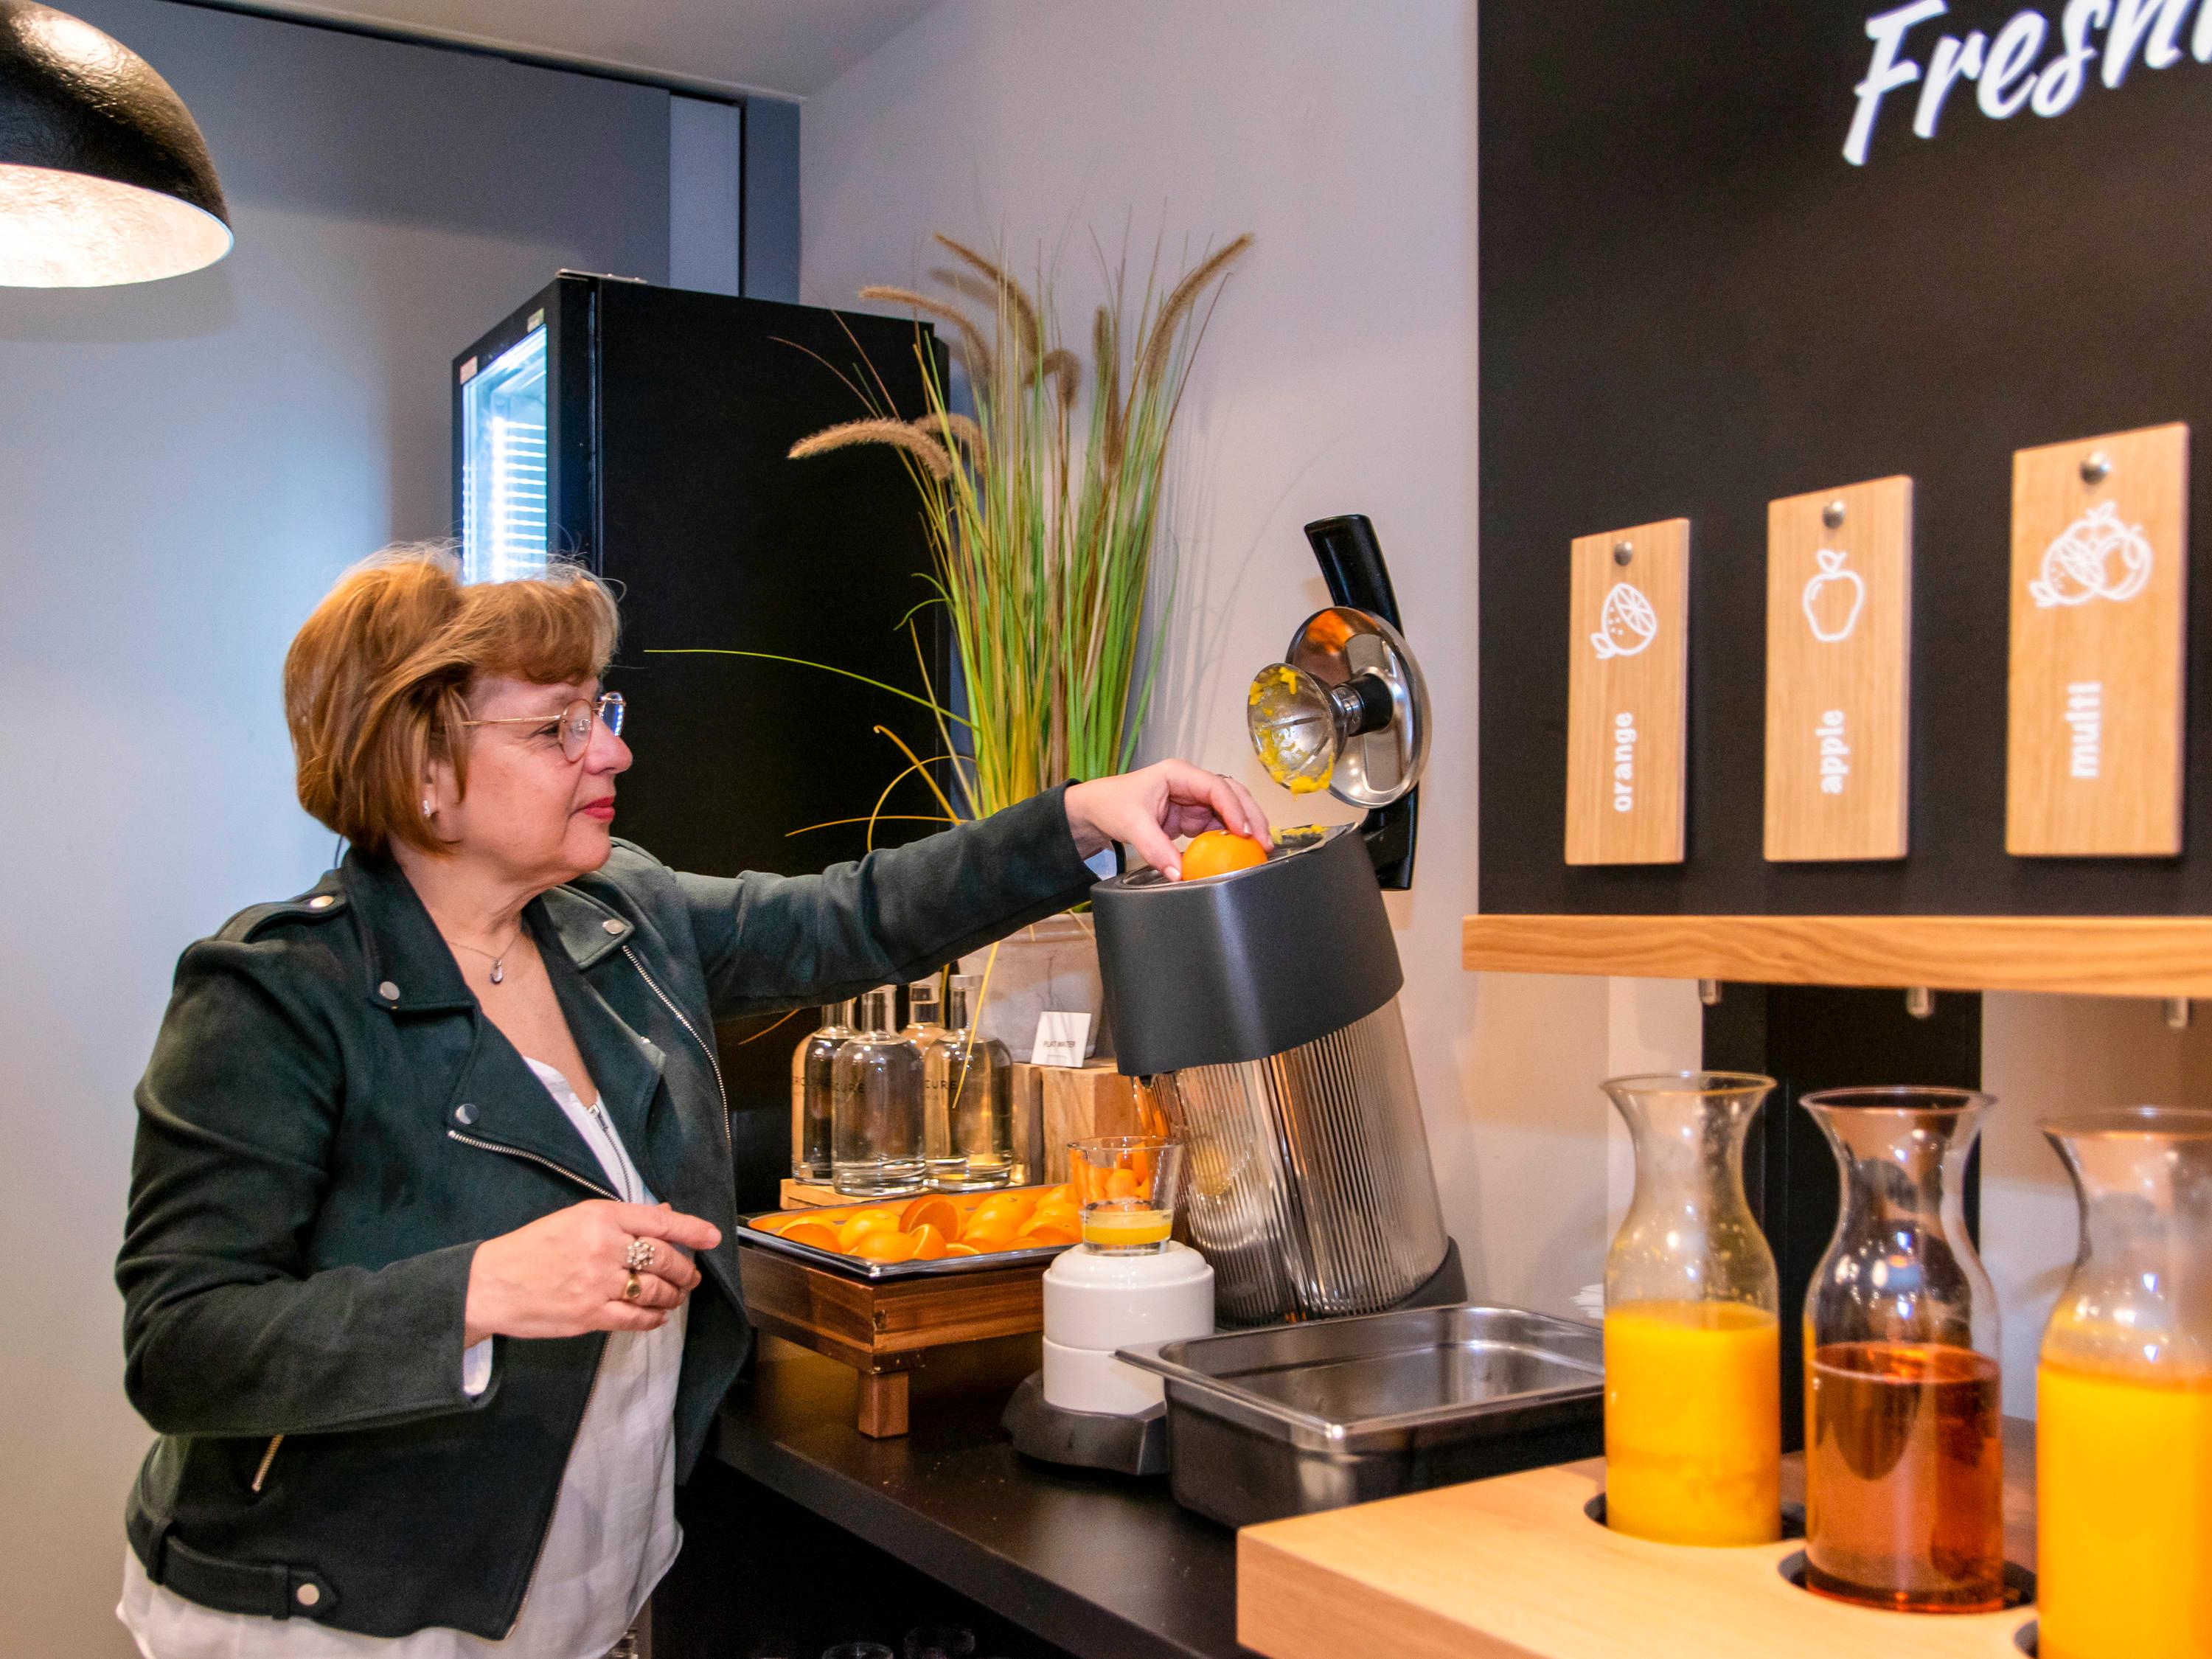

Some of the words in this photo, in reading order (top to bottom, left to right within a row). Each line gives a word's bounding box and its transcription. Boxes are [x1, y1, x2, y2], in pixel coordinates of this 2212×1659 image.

[1843, 0, 2212, 166] Fresh
[1614, 712, 1637, 812] orange
[1815, 710, 1849, 794] apple
[2065, 683, 2101, 779] multi
